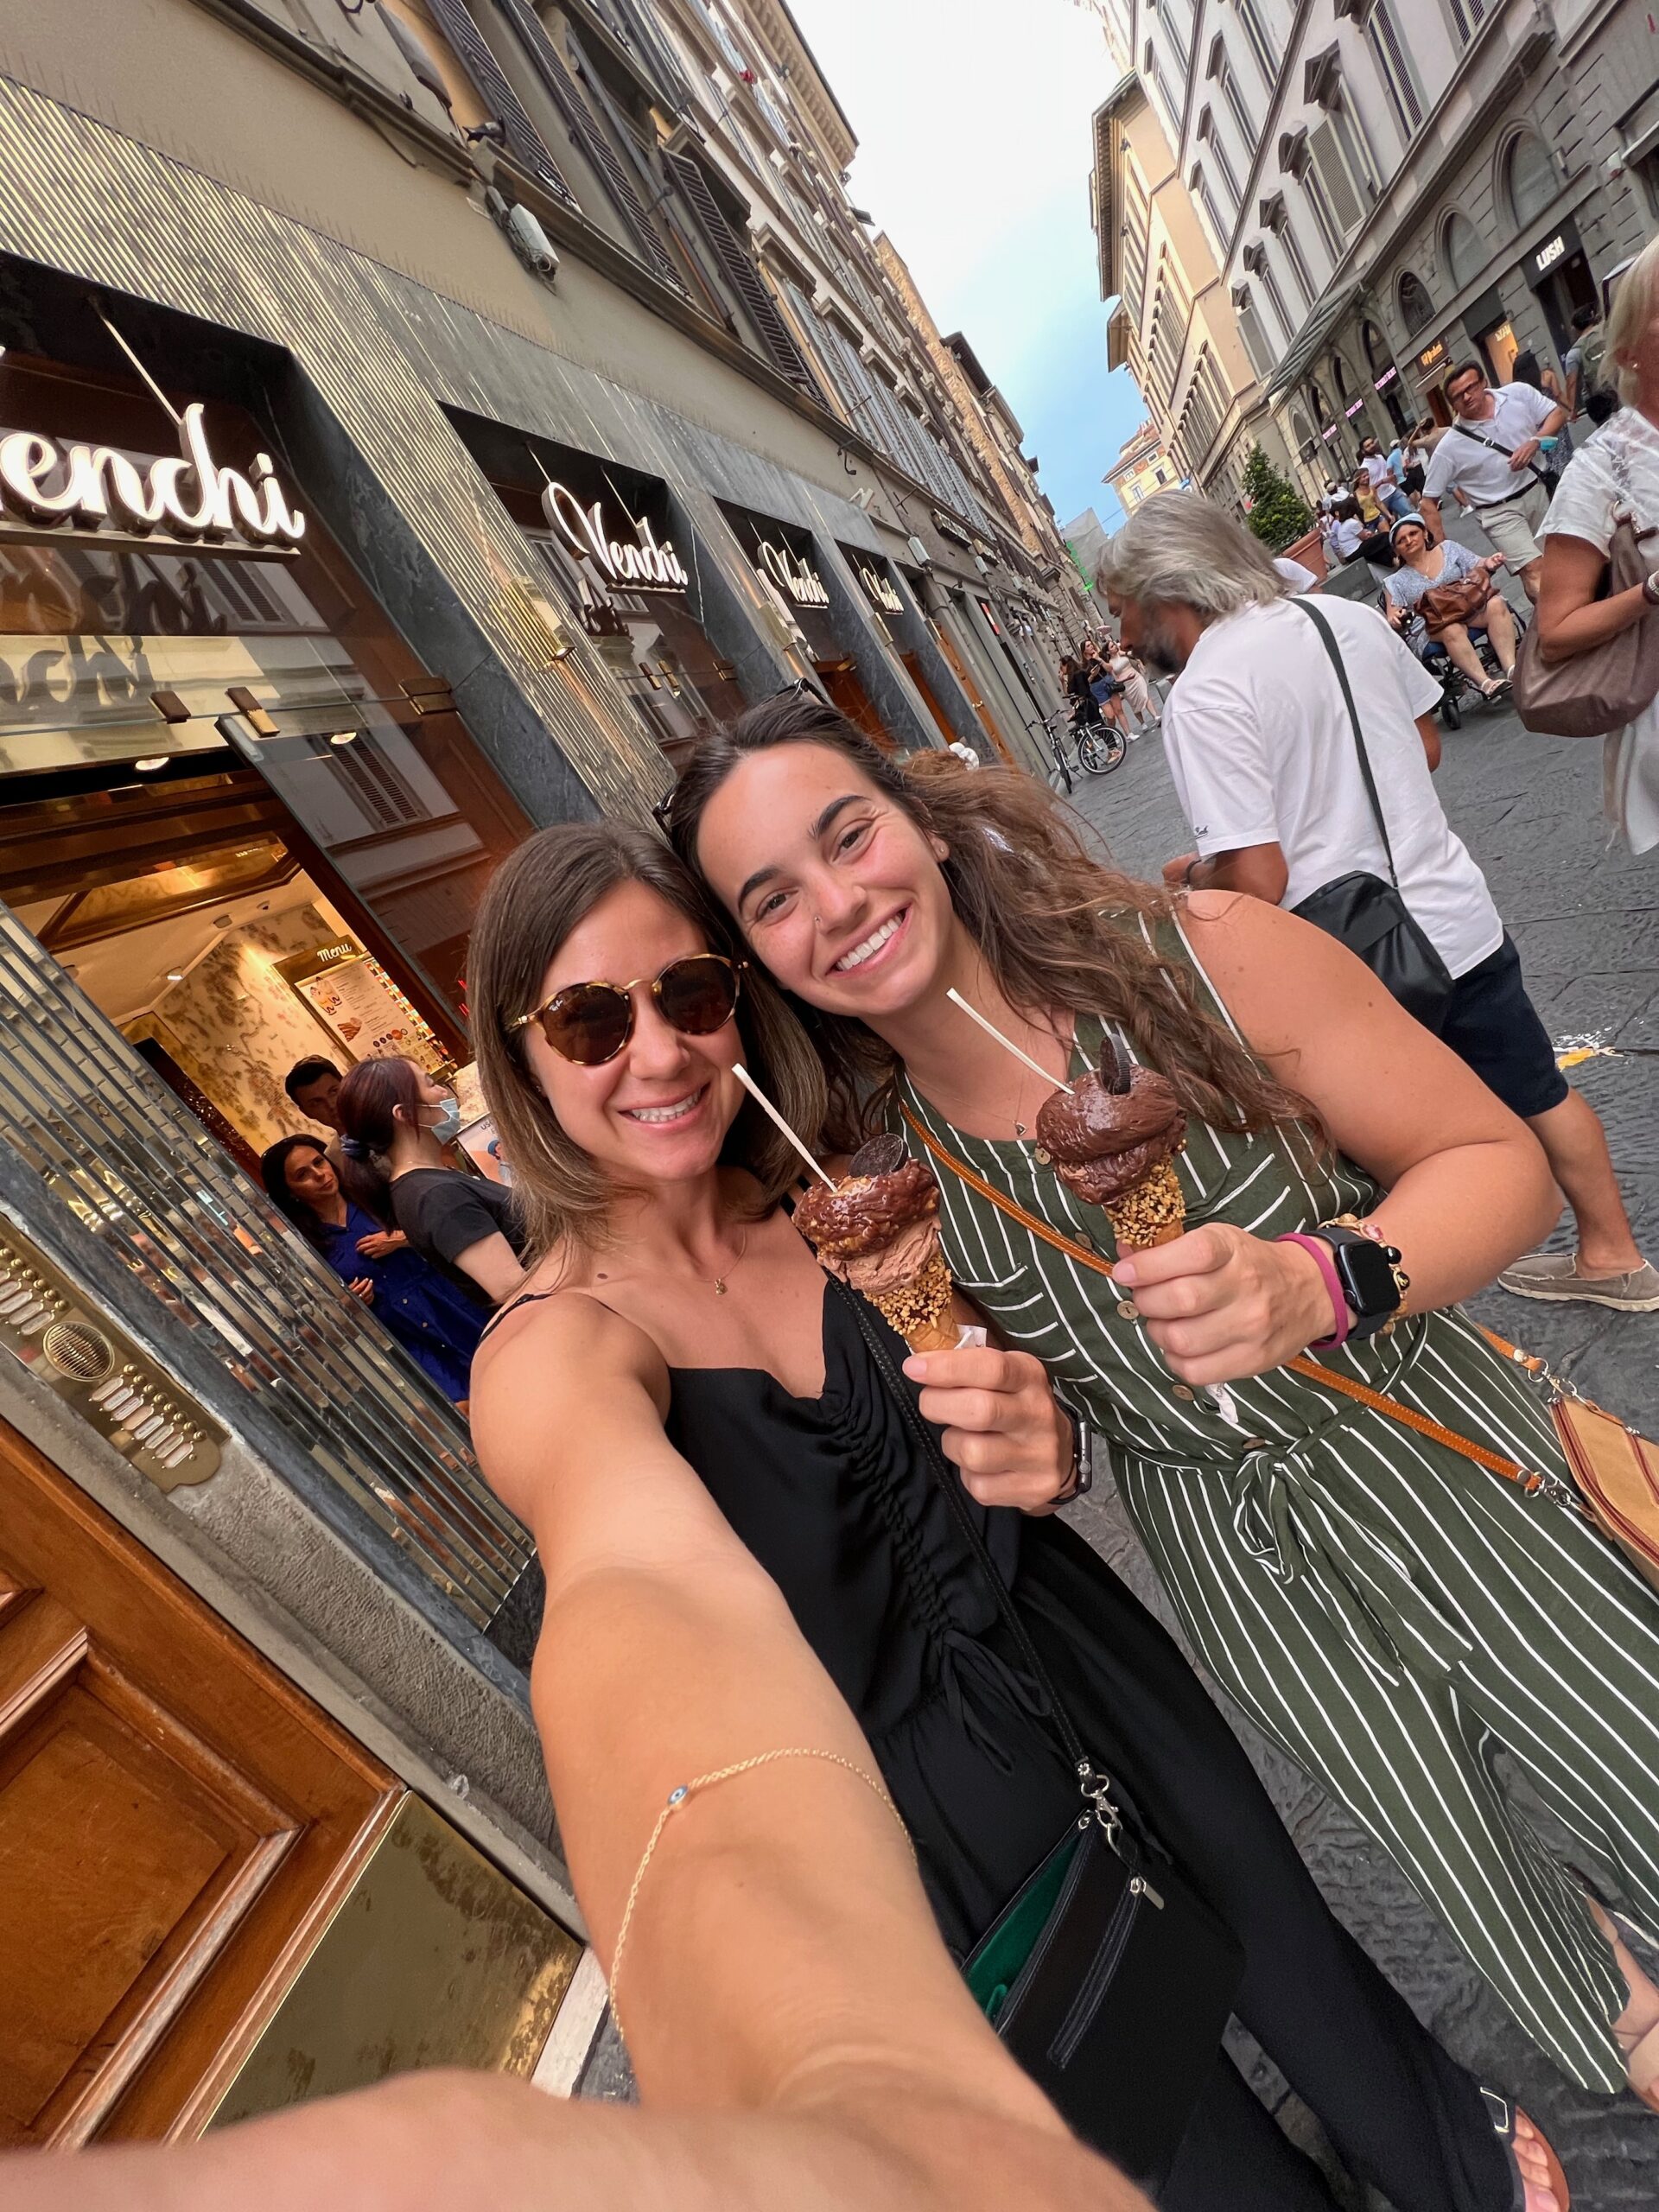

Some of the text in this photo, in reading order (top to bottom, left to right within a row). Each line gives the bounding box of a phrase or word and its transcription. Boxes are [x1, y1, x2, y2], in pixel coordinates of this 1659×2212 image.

[1535, 235, 1565, 271] LUSH
[0, 402, 306, 543] enchi
[543, 481, 689, 587] Venchi
[760, 541, 830, 605] Venchi
[316, 943, 353, 963] Menu
